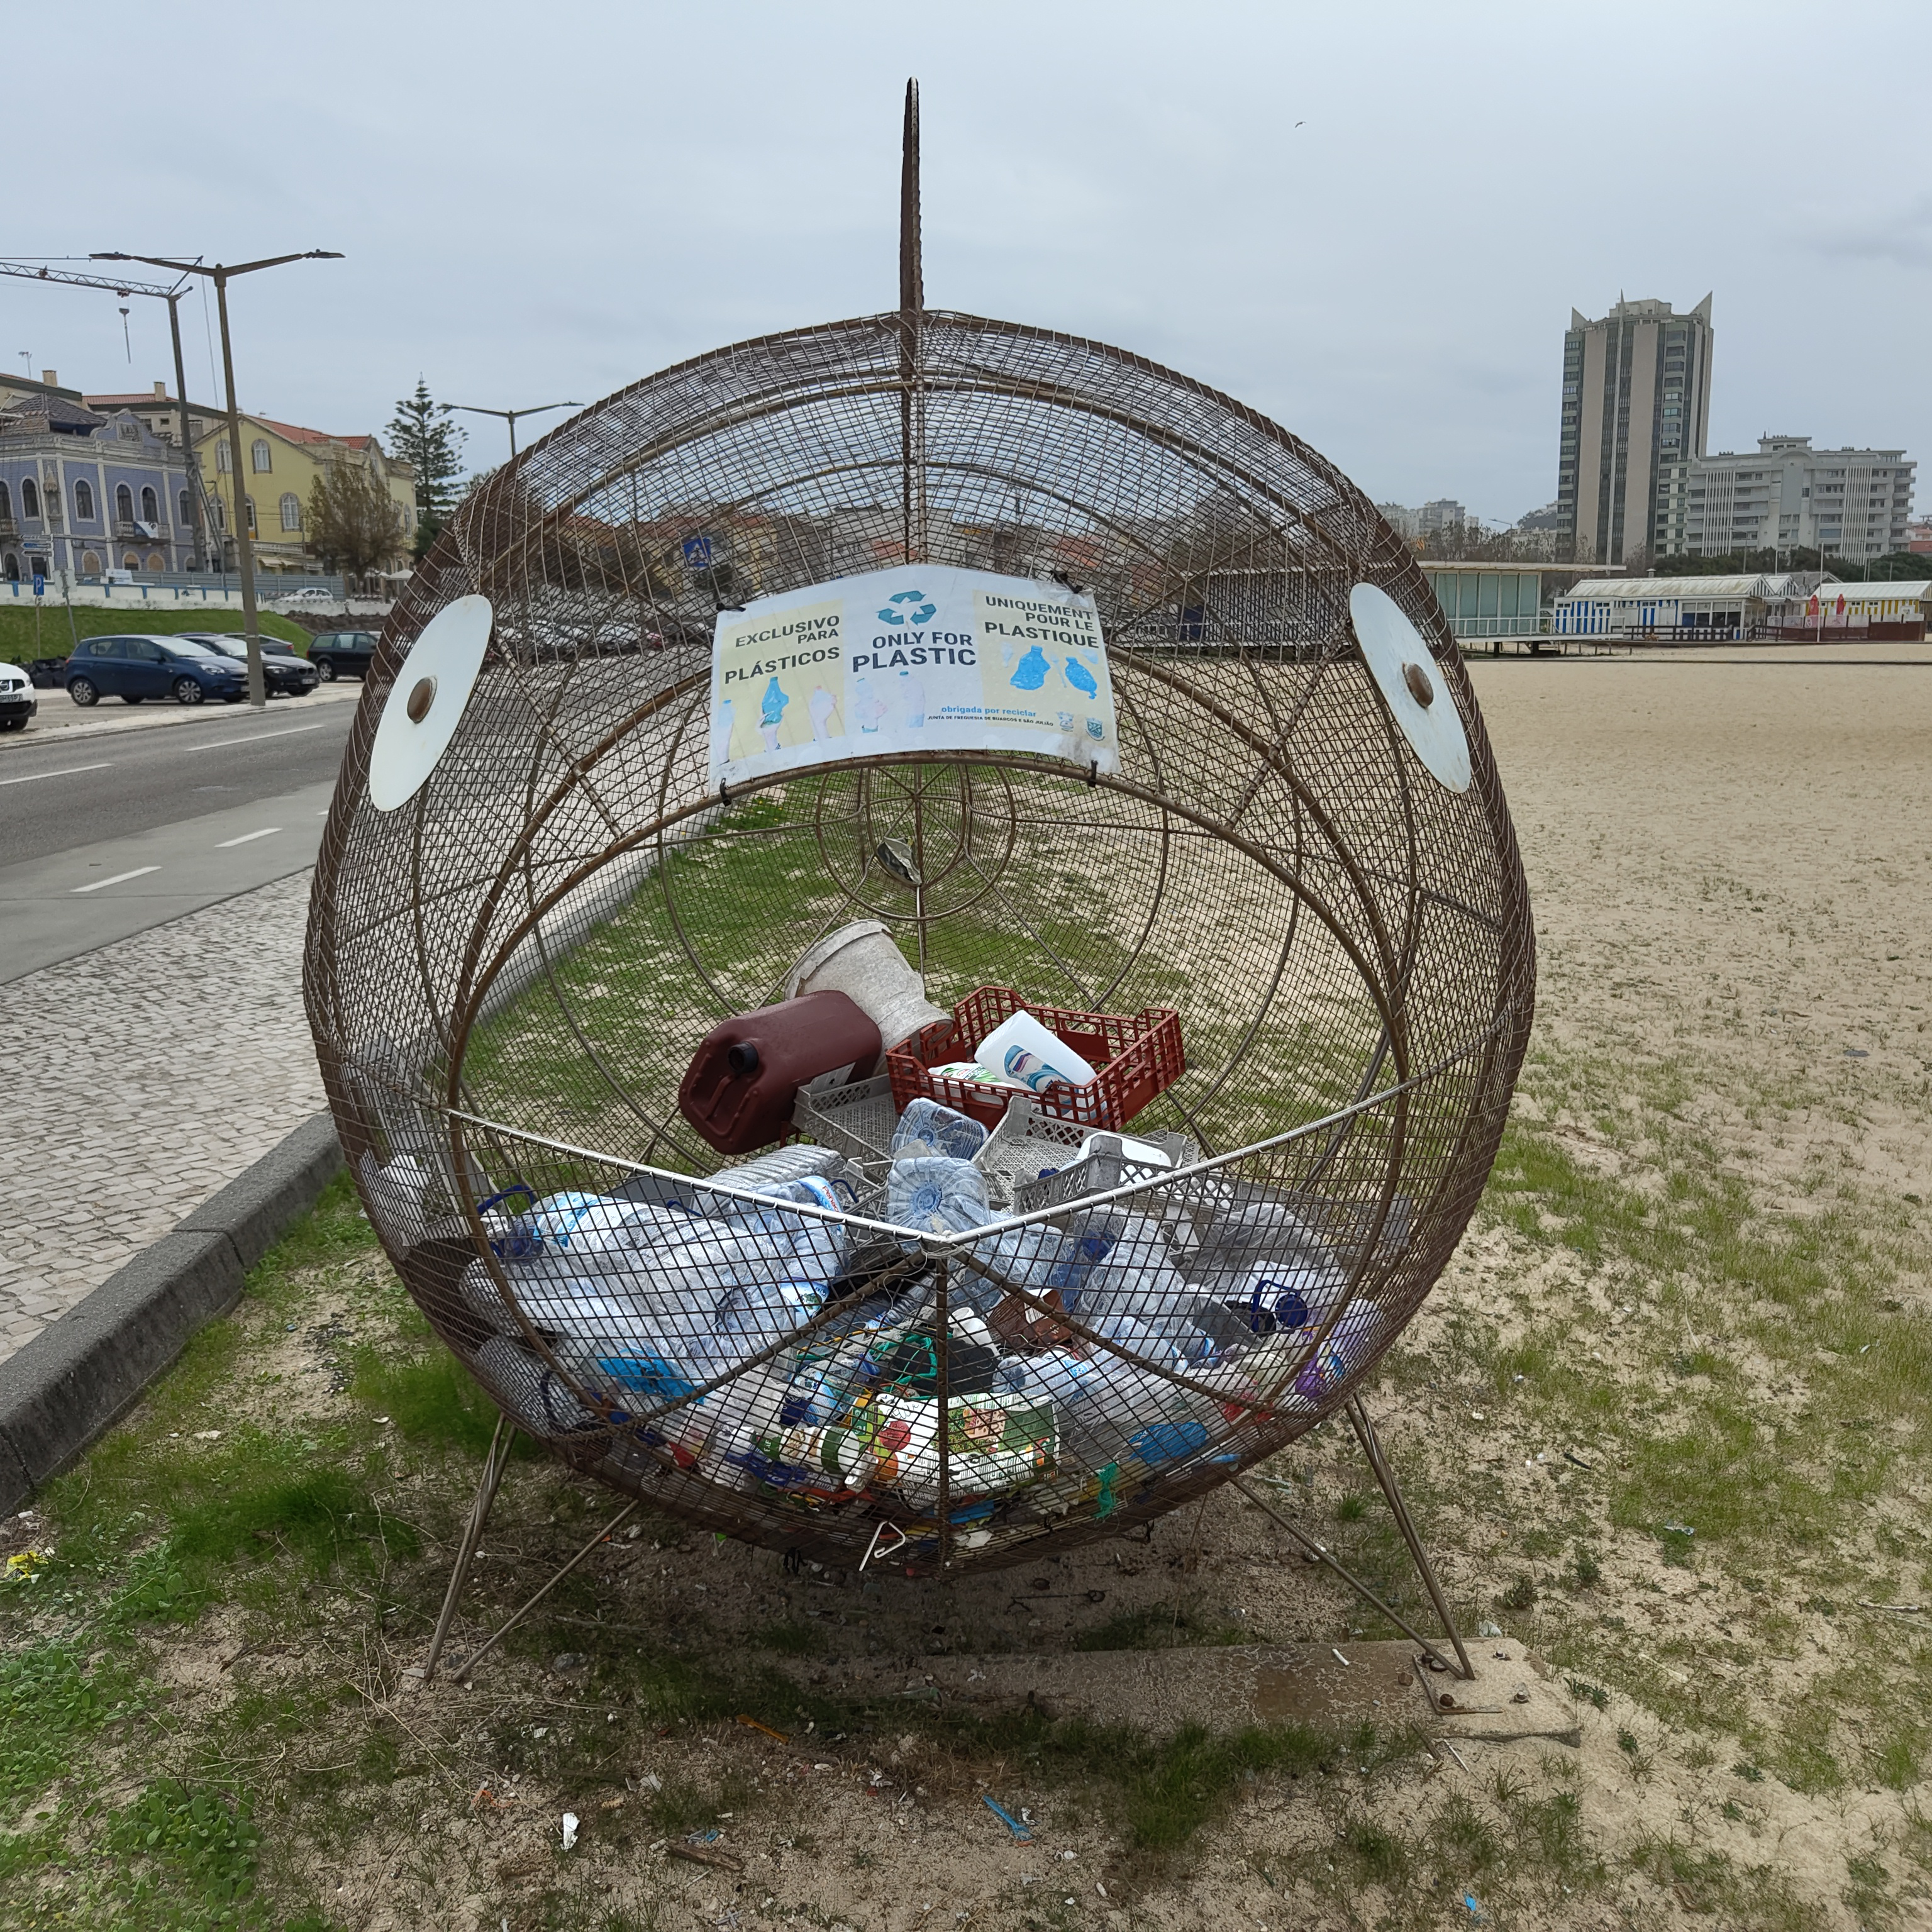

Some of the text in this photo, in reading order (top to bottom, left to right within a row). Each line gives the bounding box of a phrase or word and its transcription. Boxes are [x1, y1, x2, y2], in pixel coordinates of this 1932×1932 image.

[985, 596, 1093, 620] UNIQUEMENT
[735, 615, 840, 648] EXCLUSIVO
[1025, 612, 1094, 631] POUR LE
[797, 628, 839, 644] PARA
[872, 631, 973, 649] ONLY FOR
[984, 621, 1099, 648] PLASTIQUE
[724, 647, 840, 684] PLÁSTICOS
[852, 647, 977, 673] PLASTIC
[941, 706, 982, 714] obrigada
[1002, 709, 1037, 717] reciclar
